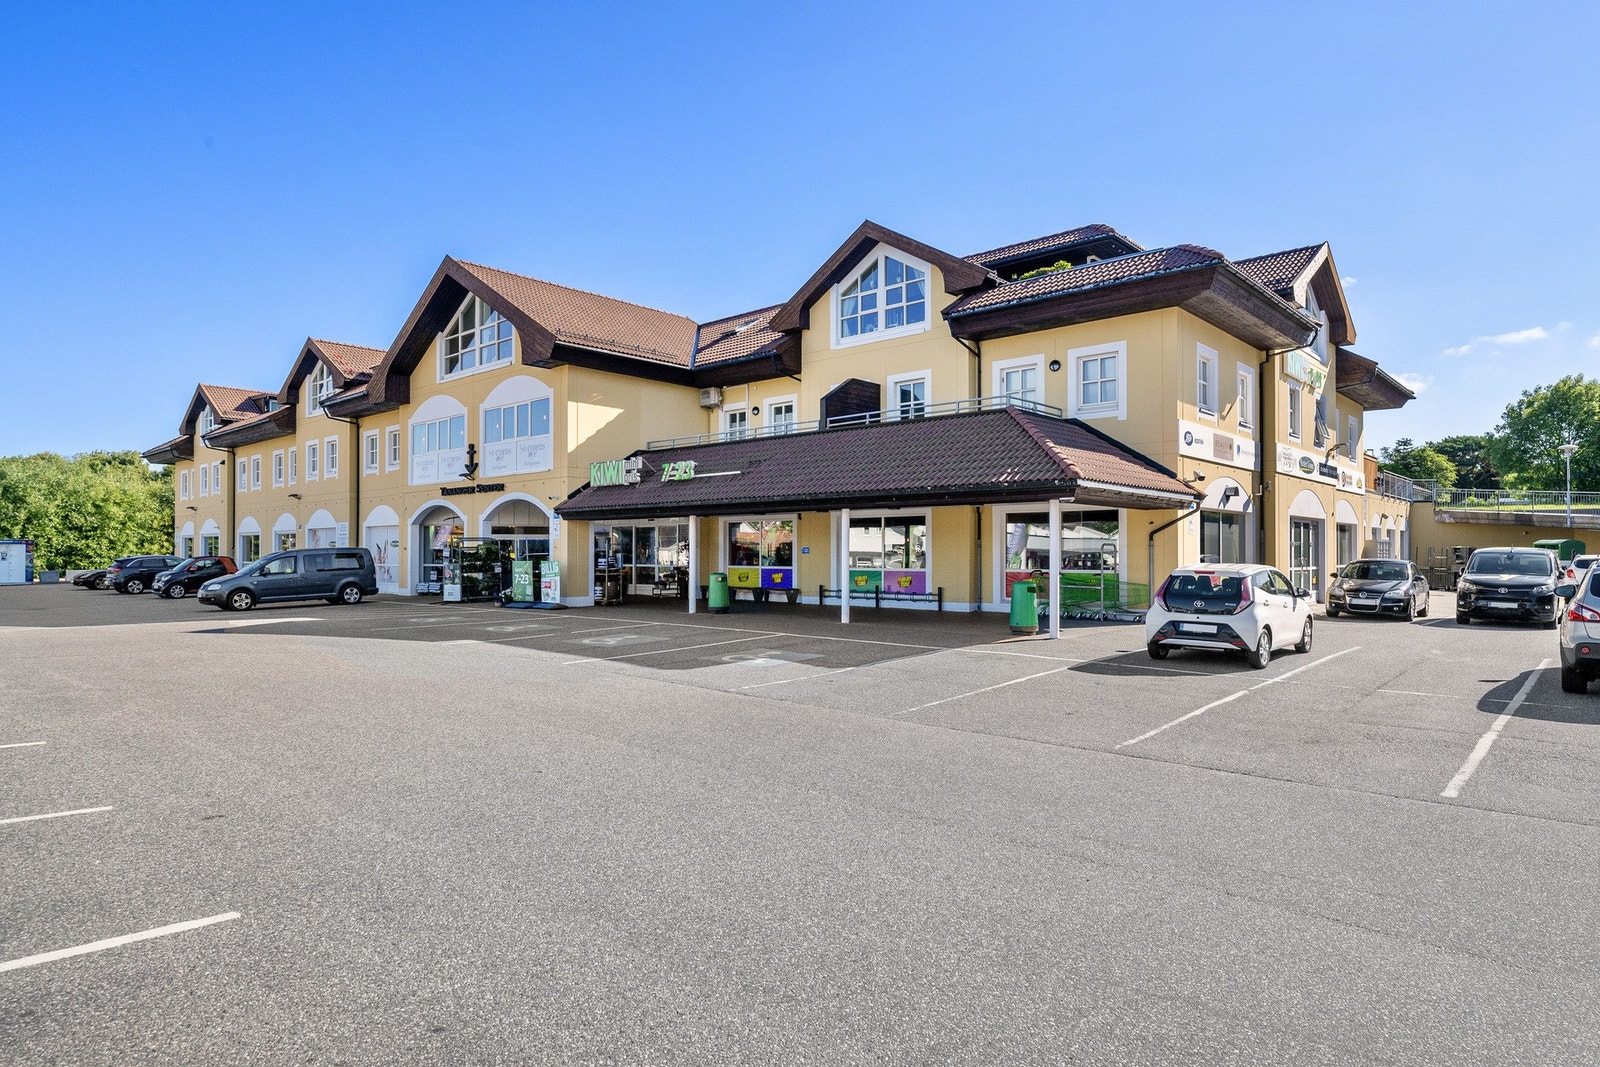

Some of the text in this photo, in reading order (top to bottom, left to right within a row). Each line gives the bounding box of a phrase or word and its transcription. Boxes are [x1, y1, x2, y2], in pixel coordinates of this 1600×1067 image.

[590, 460, 624, 487] KIWI
[661, 461, 696, 482] 7-23
[514, 574, 530, 584] 7-23
